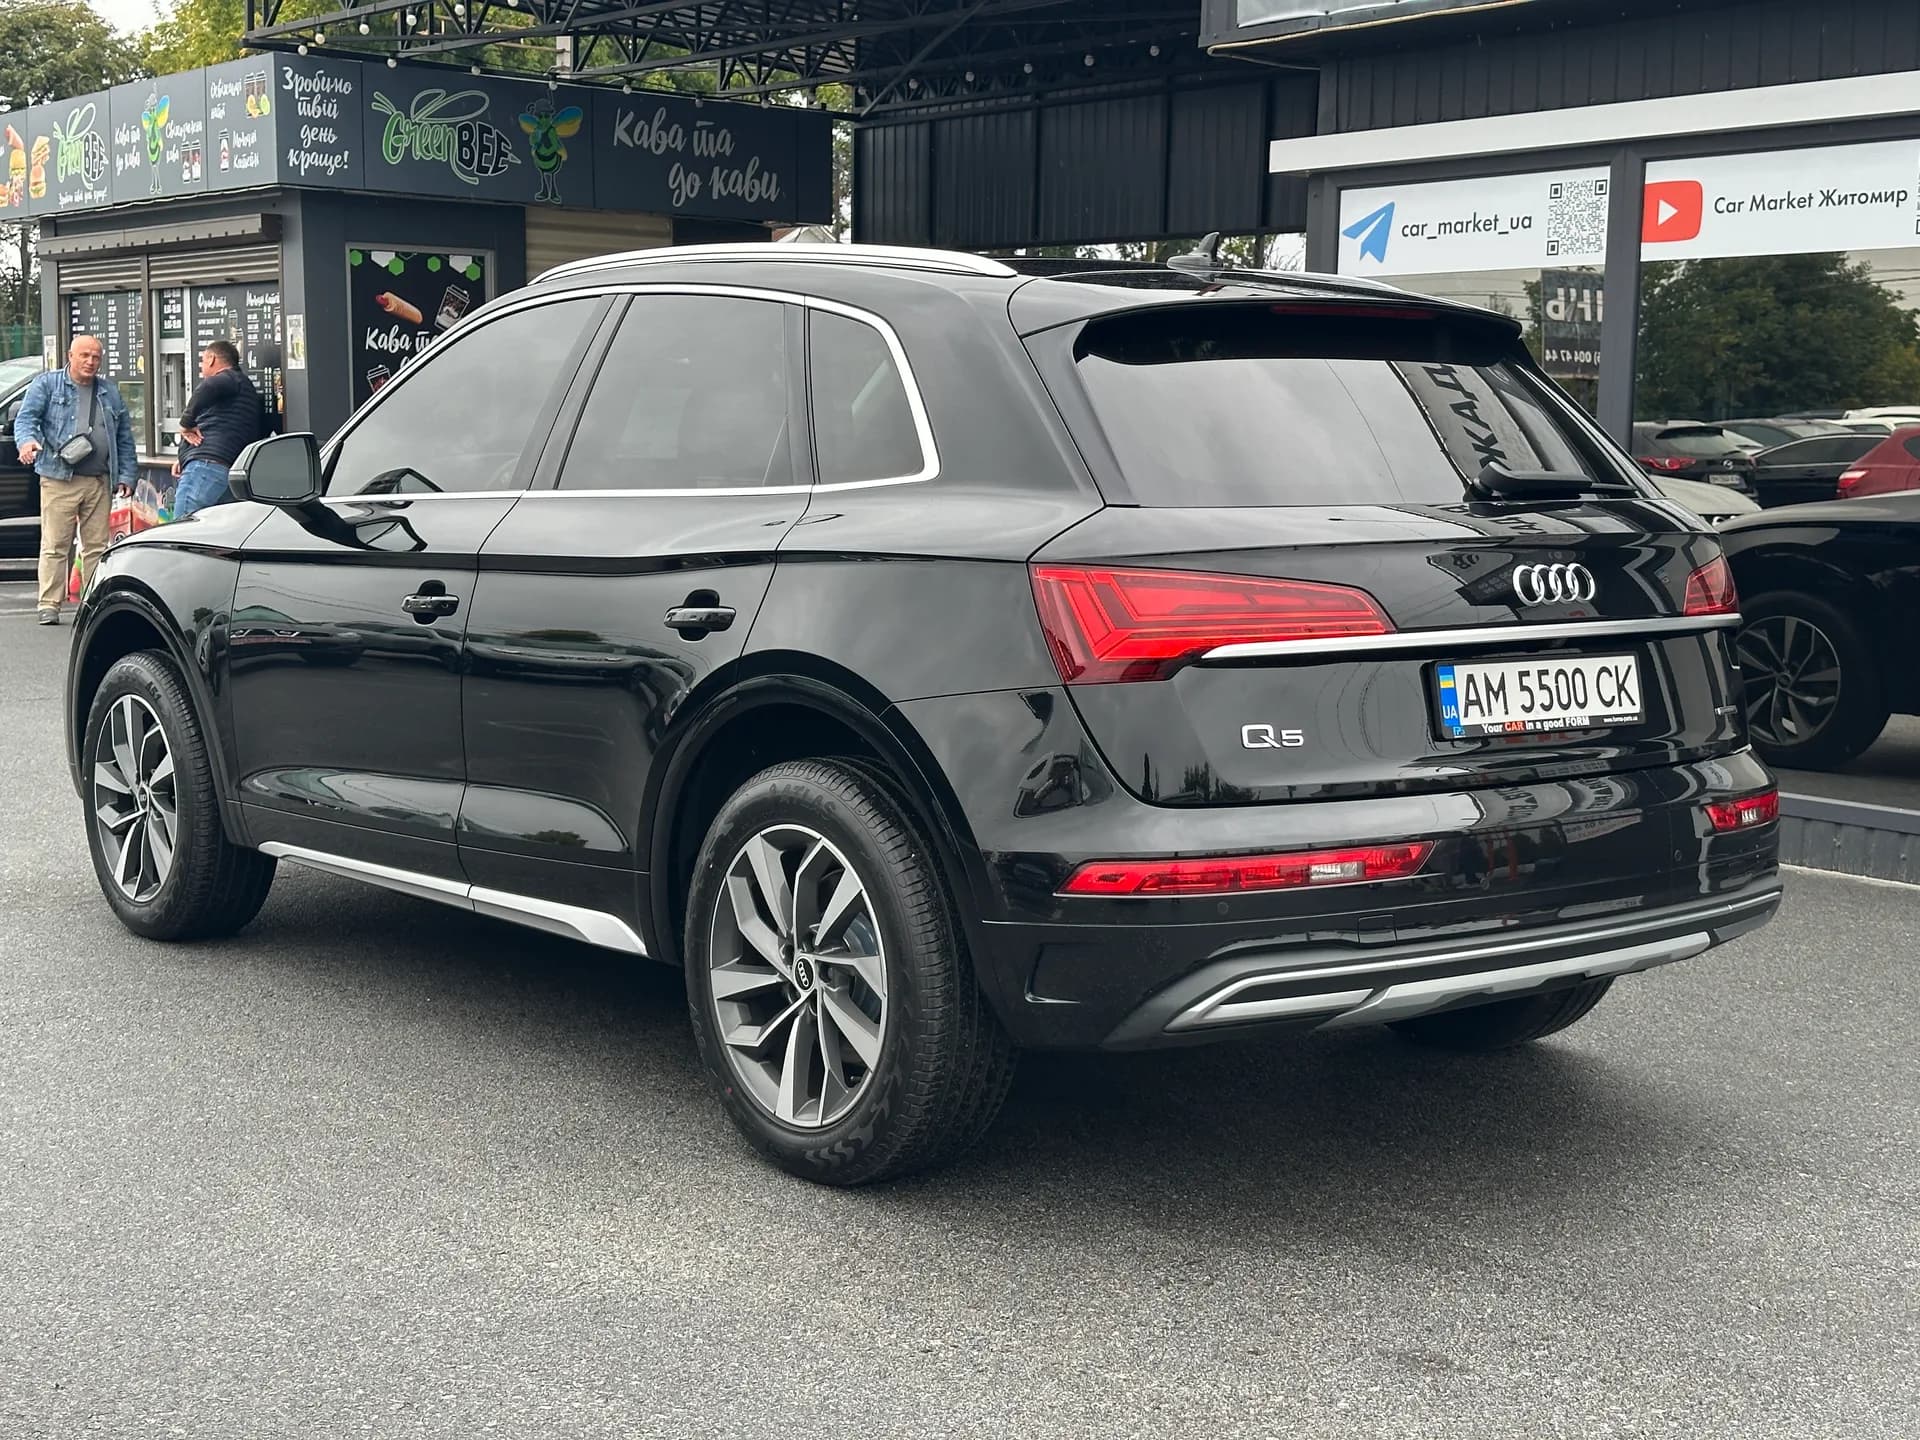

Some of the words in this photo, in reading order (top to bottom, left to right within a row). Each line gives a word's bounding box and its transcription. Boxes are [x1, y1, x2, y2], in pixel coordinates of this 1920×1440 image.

[282, 66, 352, 99] Зробимо
[298, 93, 339, 119] твій
[300, 124, 338, 148] день
[613, 106, 687, 155] Кава
[693, 120, 735, 158] та
[287, 148, 349, 176] краще!
[668, 162, 703, 207] до
[709, 156, 780, 203] кави
[1714, 197, 1744, 214] Car
[1749, 191, 1814, 212] Market
[1818, 189, 1908, 208] Житомир
[1401, 212, 1533, 239] car_market_ua
[365, 324, 412, 354] Кава
[1463, 671, 1509, 718] AM
[1518, 667, 1588, 714] 5500
[1595, 664, 1636, 708] CK
[1442, 704, 1458, 719] UA
[1481, 723, 1503, 734] Your
[1504, 721, 1524, 732] CAR
[1543, 719, 1564, 731] good
[1565, 716, 1590, 727] FORM
[1241, 724, 1304, 748] Q5
